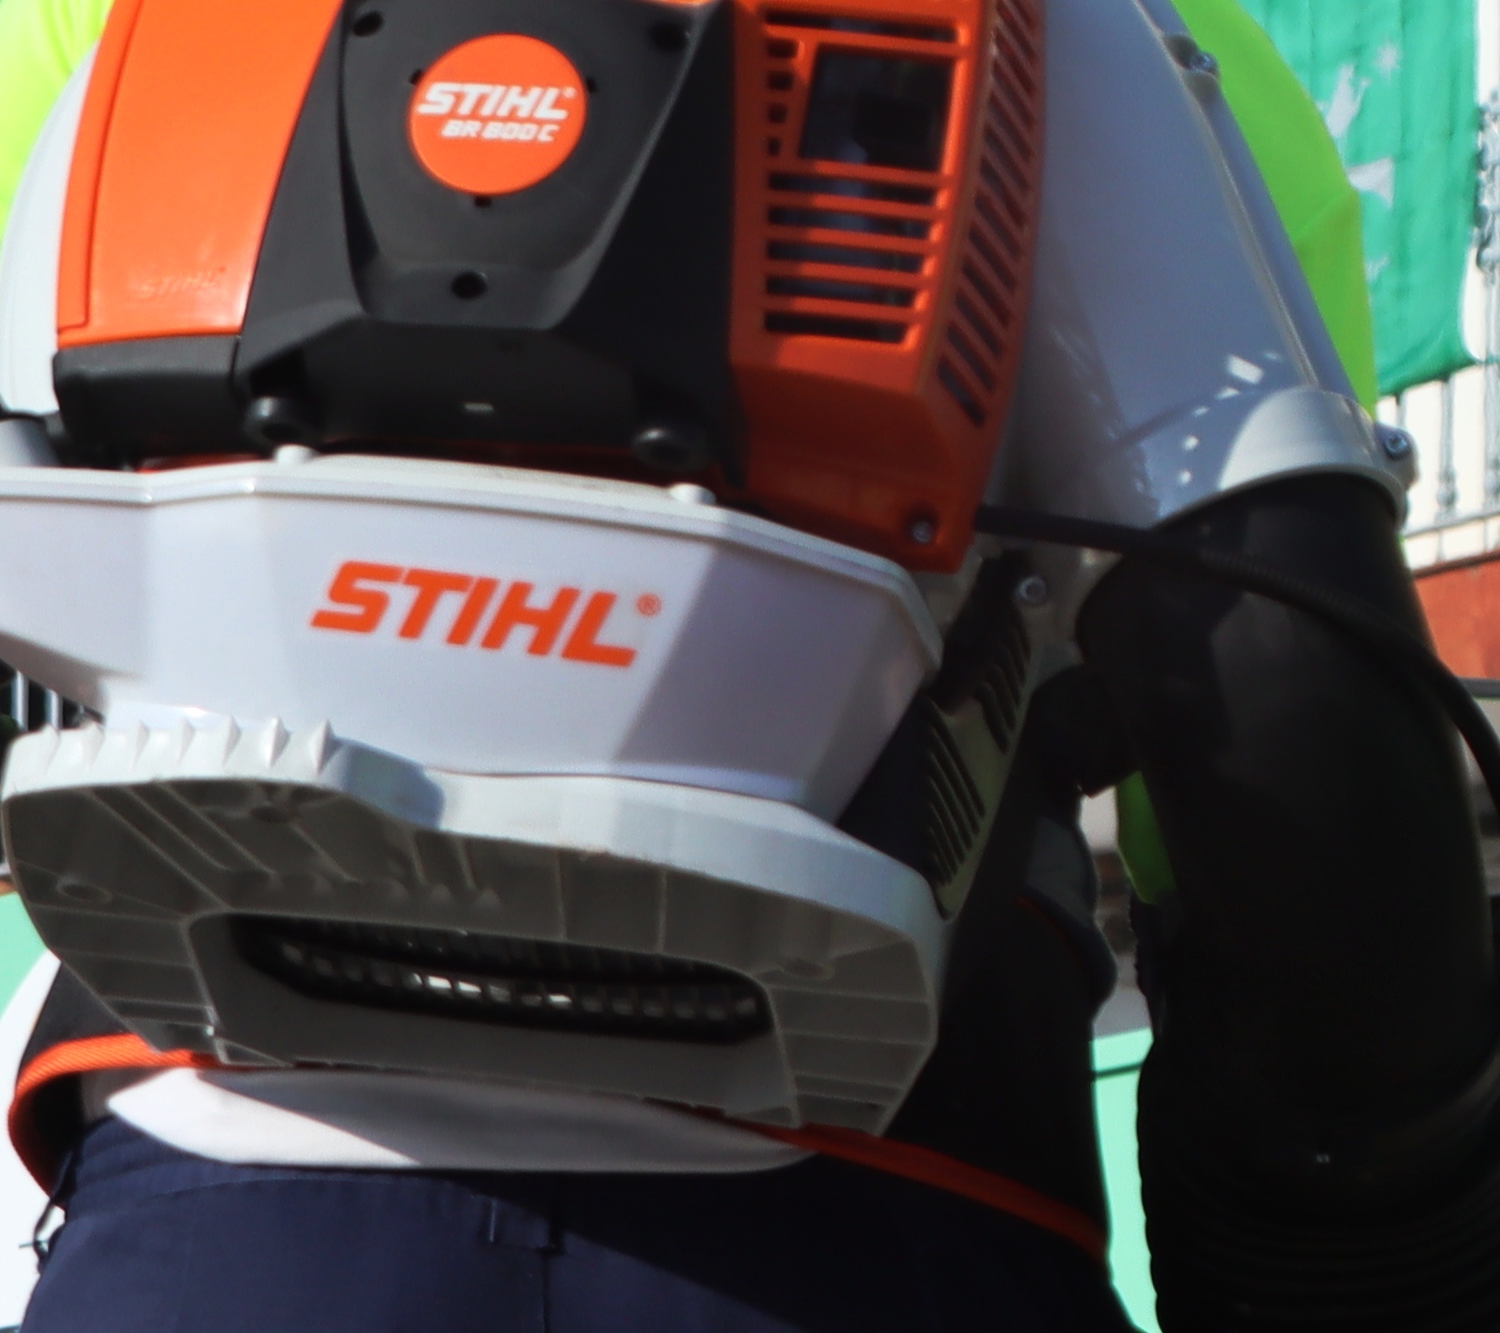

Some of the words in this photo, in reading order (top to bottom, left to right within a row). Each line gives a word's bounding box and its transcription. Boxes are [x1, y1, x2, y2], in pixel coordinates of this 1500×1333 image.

[417, 81, 568, 121] STIHL
[441, 119, 482, 138] BR
[537, 124, 560, 142] C
[310, 560, 639, 668] STIHL
